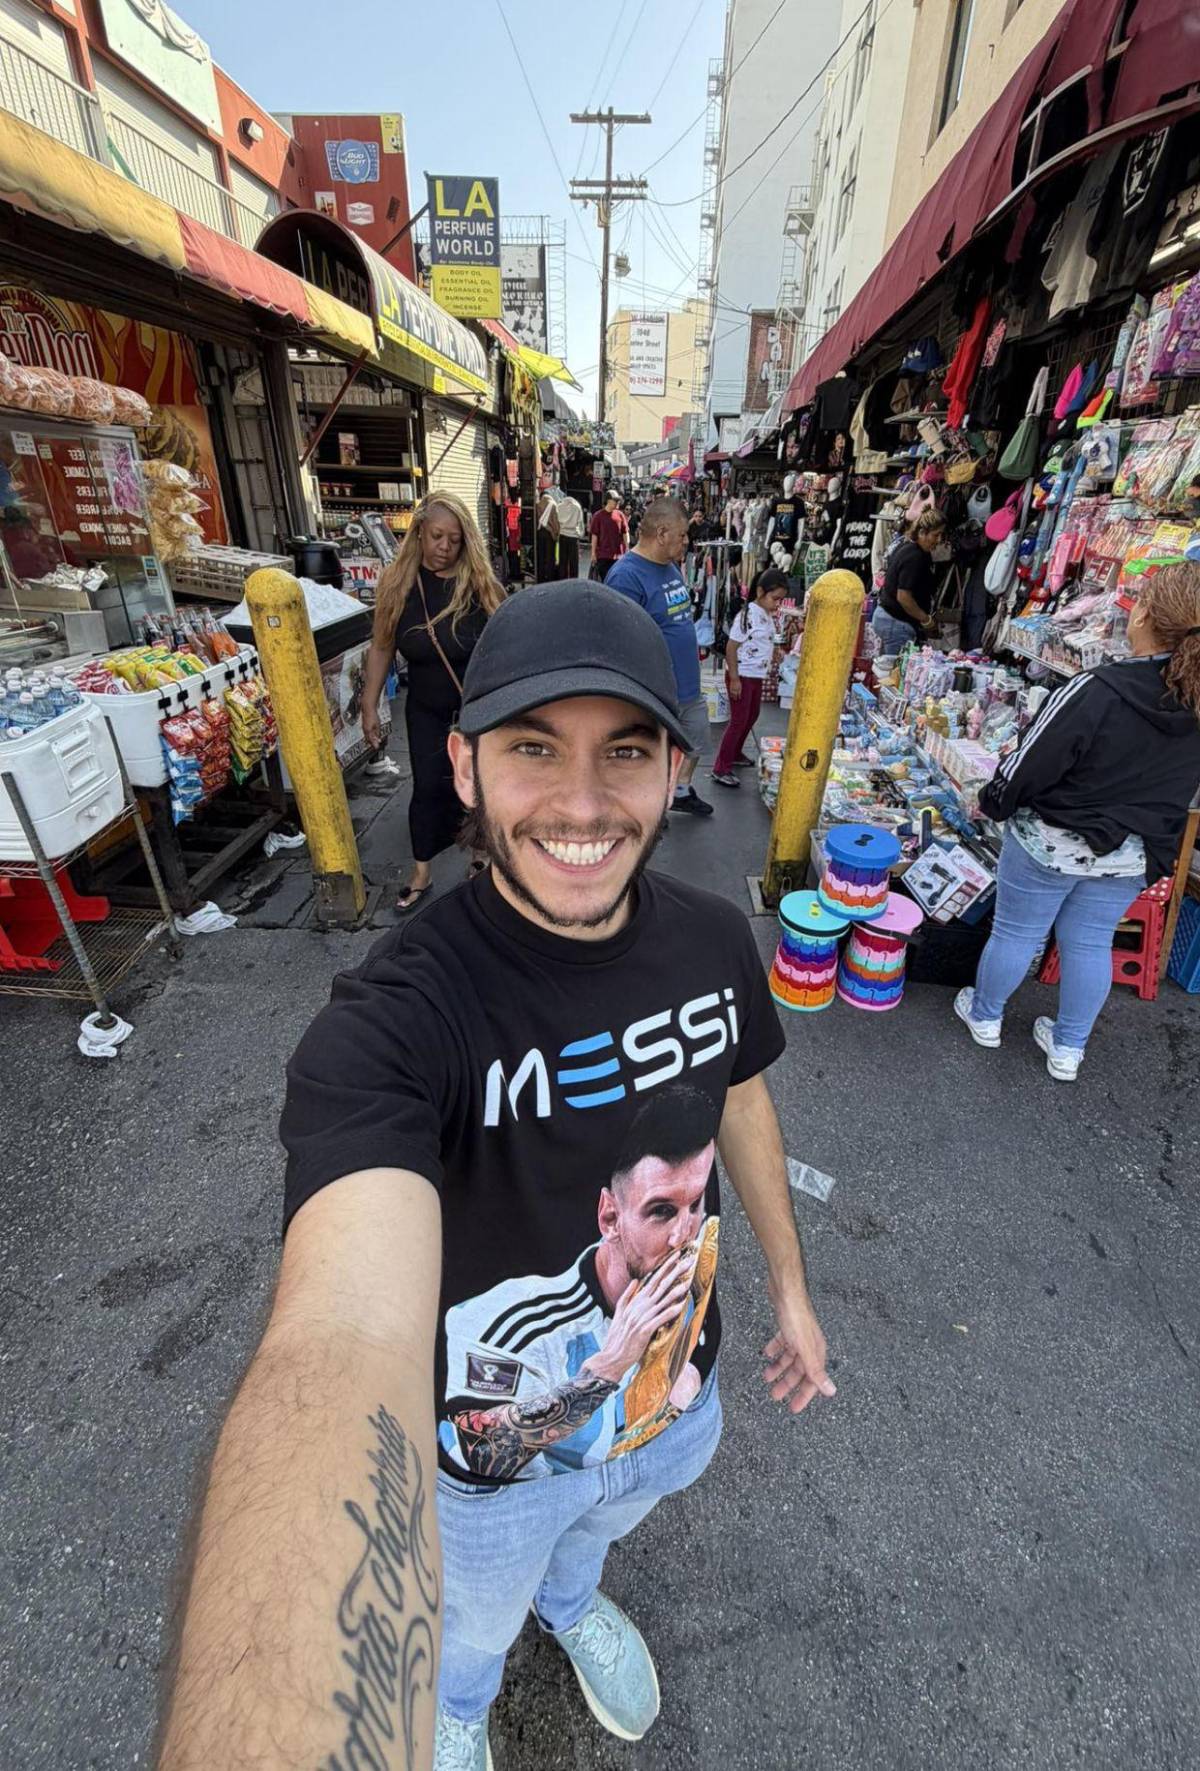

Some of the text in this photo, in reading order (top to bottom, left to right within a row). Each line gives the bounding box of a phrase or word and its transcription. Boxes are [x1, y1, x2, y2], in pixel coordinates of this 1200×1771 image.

[435, 180, 495, 218] LA
[434, 220, 495, 237] PERFUME
[436, 239, 494, 256] WORLD
[376, 264, 402, 325] LA
[2, 307, 26, 333] The
[845, 521, 873, 533] PRAISE
[849, 535, 867, 546] THE
[843, 547, 871, 560] LORD
[343, 566, 377, 580] TM
